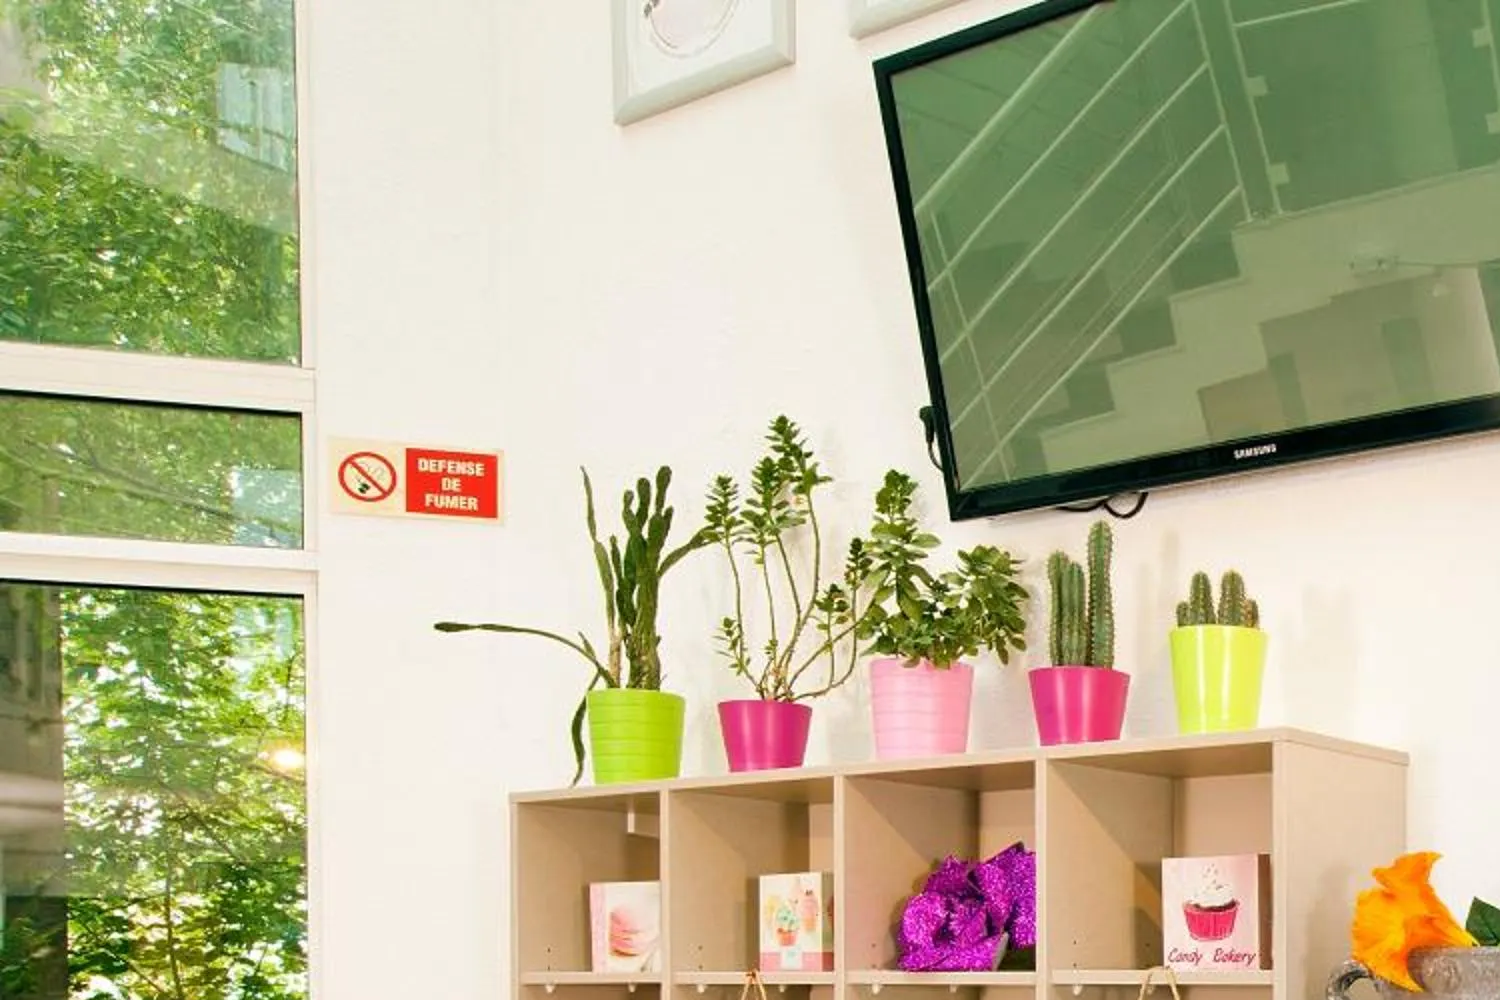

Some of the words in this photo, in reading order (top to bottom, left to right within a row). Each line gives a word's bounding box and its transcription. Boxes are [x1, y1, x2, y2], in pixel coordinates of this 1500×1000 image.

[1233, 443, 1277, 460] SAMSUNG
[417, 457, 486, 477] DEFENSE
[441, 477, 462, 493] DE
[424, 493, 479, 511] FUMER
[1167, 947, 1203, 966] Candy
[1212, 947, 1257, 966] Bakery
